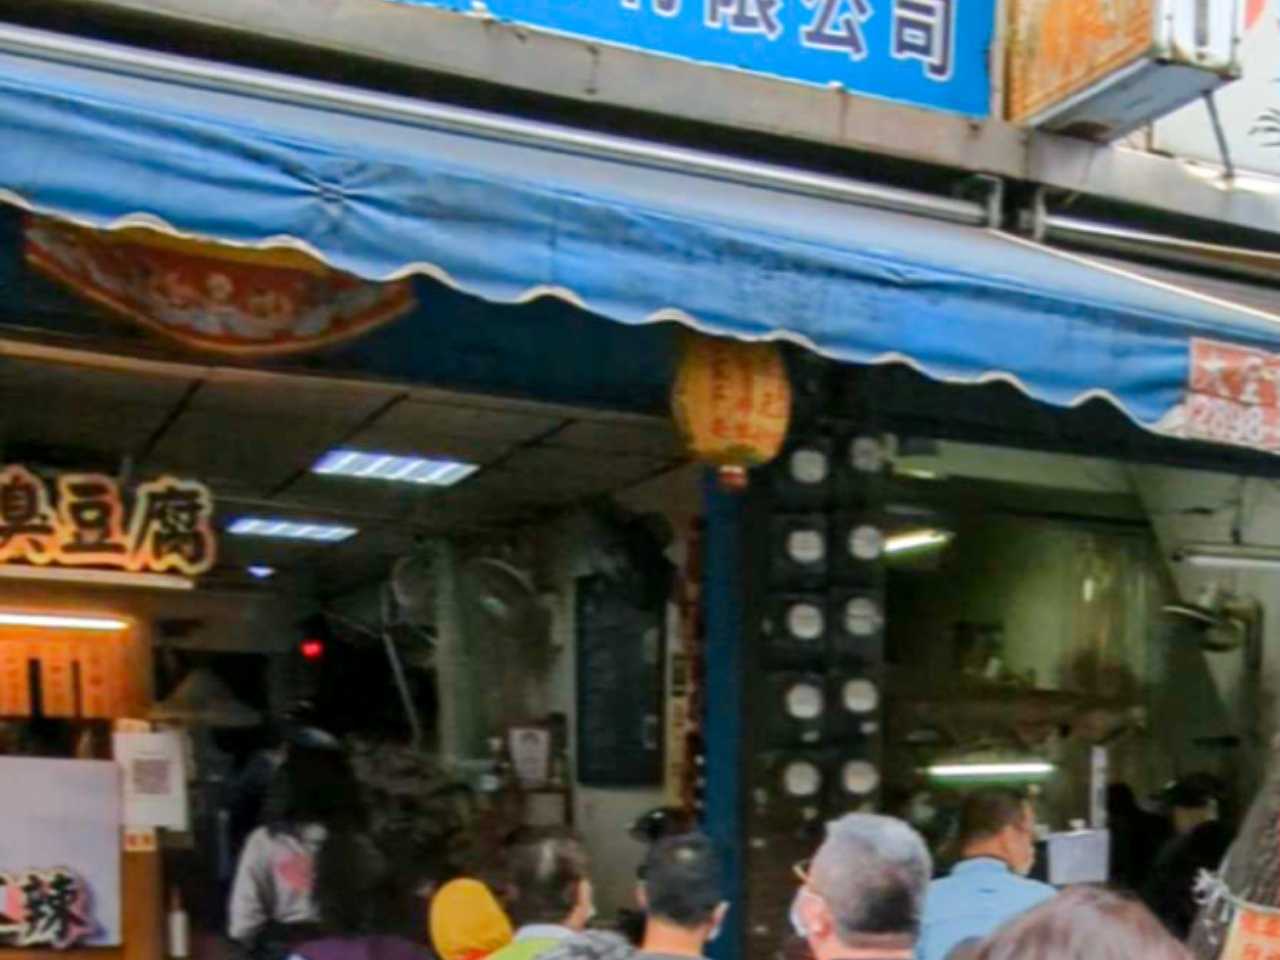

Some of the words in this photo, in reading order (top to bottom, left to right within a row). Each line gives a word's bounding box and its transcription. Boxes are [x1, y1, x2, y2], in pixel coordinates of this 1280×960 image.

[622, 0, 955, 80] 公司
[0, 469, 214, 572] 臭豆腐
[0, 867, 90, 947] 辣
